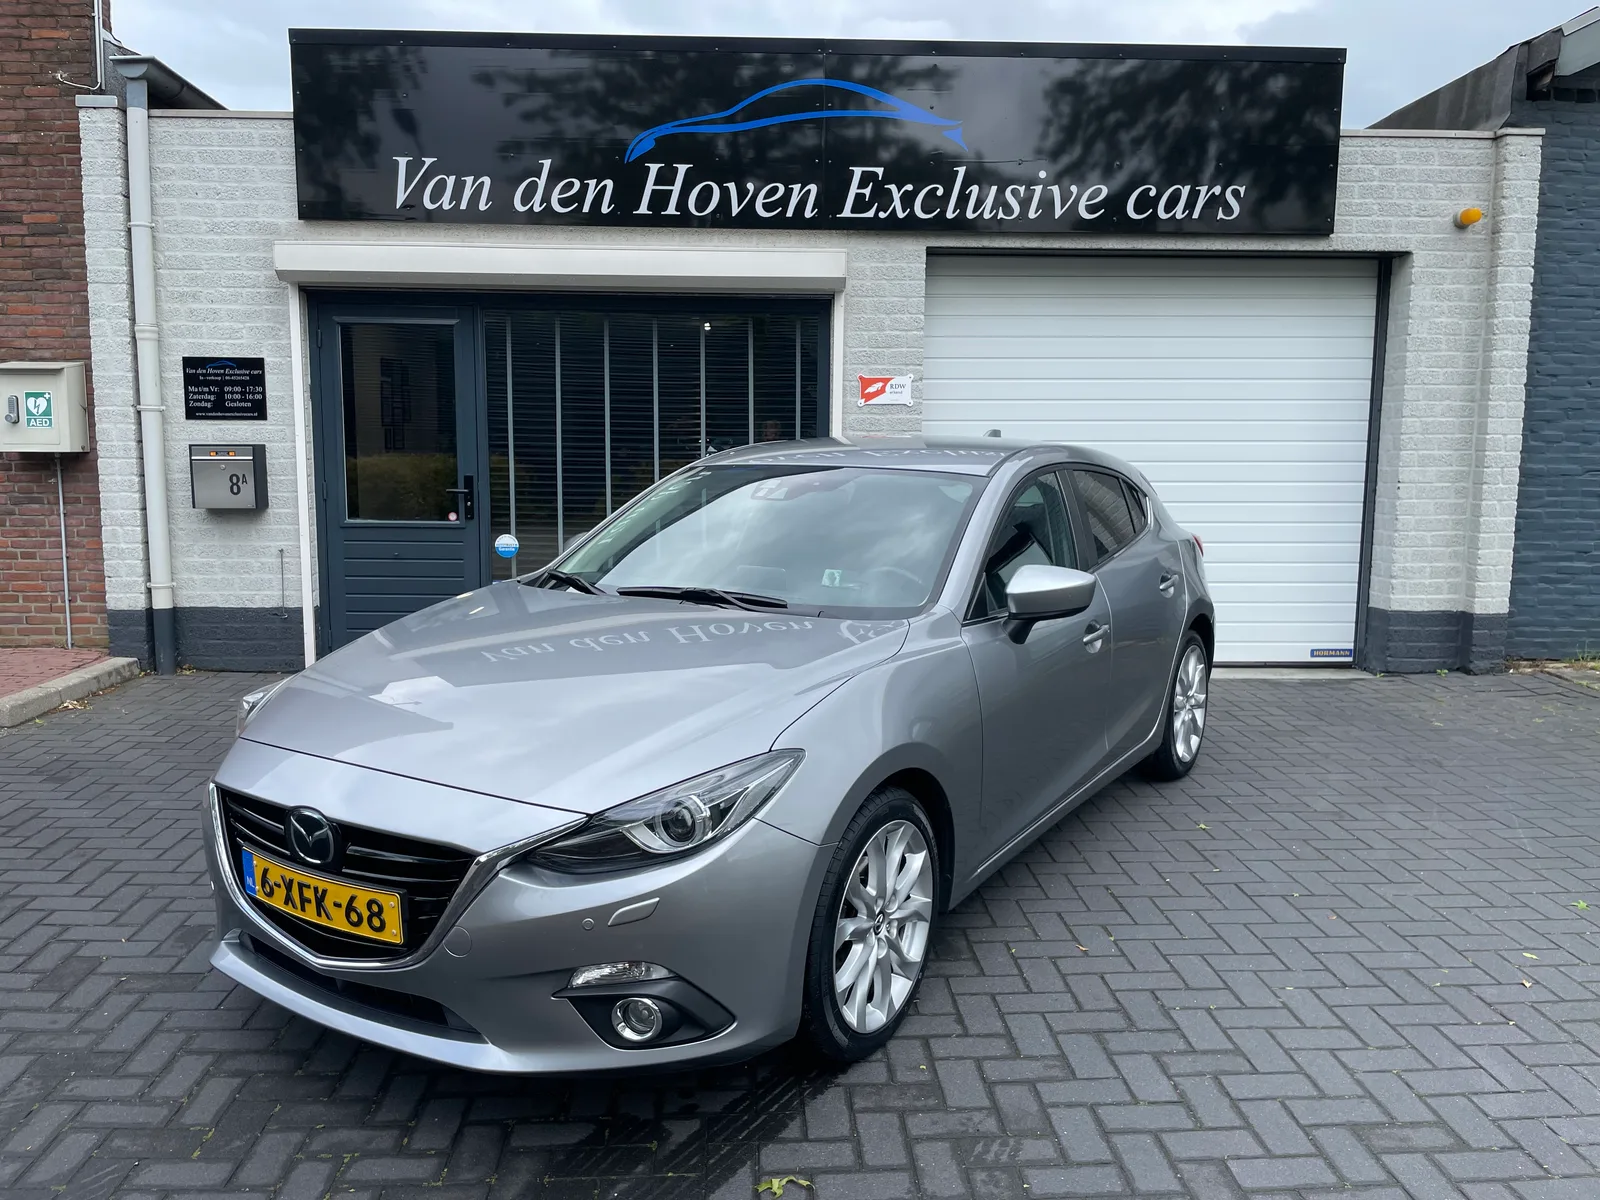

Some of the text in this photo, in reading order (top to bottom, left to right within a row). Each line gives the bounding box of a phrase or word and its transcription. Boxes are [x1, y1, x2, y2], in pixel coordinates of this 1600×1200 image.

[391, 156, 1247, 221] Van den Hoven Exclusive cars
[29, 418, 50, 427] AED
[260, 866, 387, 933] 6-XFK-68
